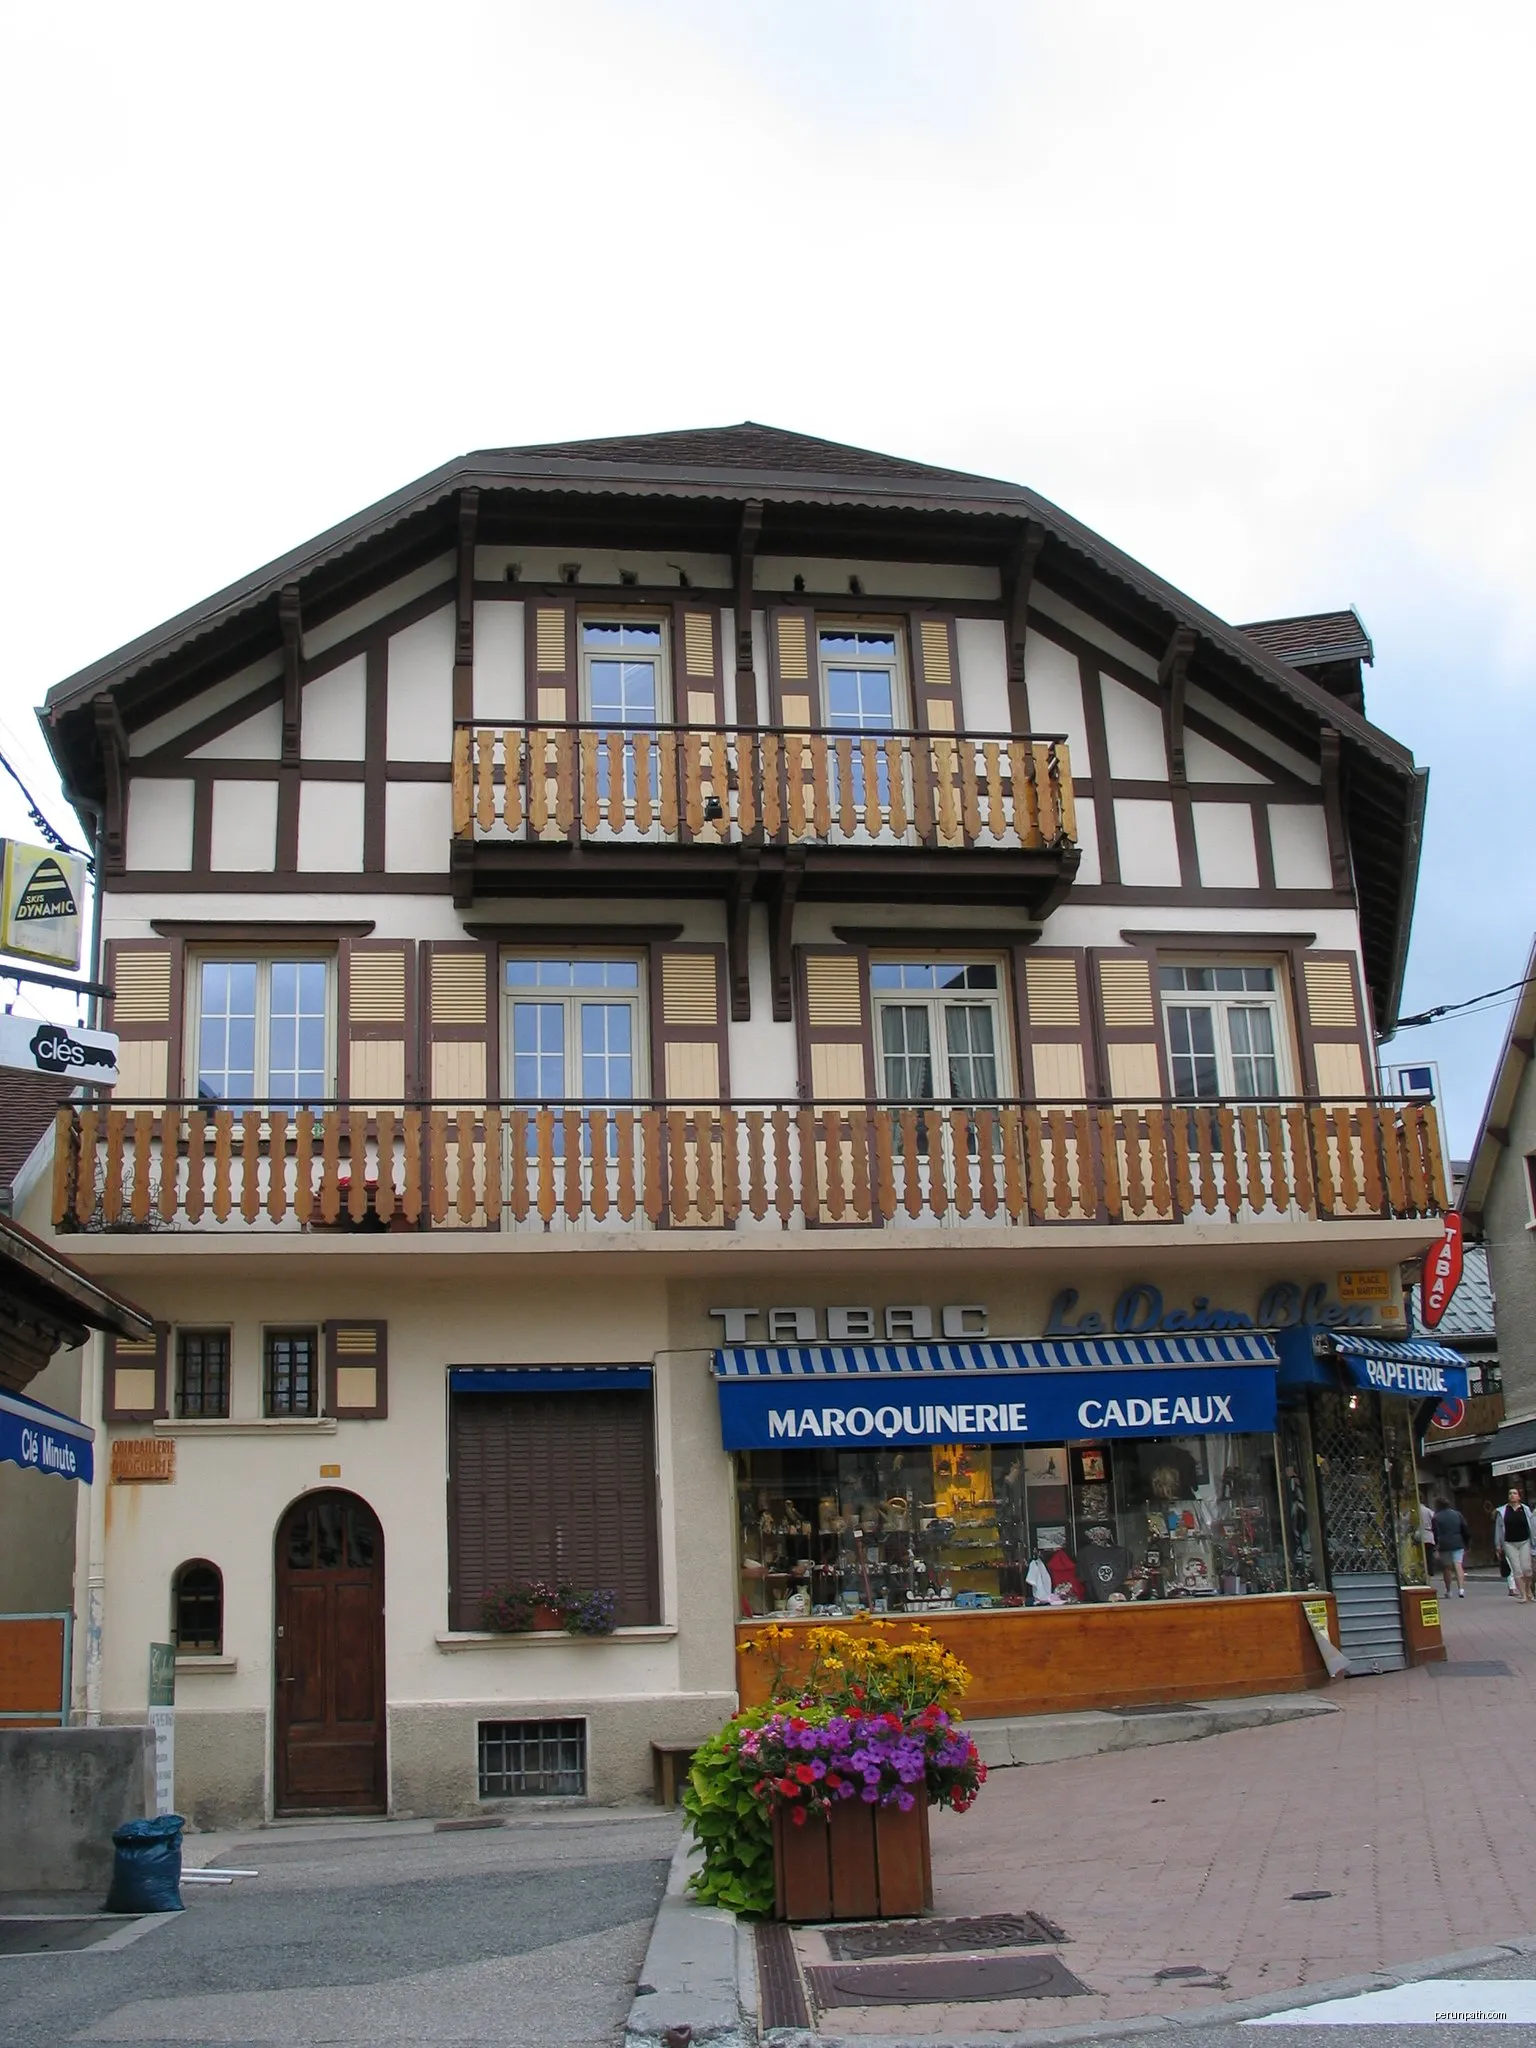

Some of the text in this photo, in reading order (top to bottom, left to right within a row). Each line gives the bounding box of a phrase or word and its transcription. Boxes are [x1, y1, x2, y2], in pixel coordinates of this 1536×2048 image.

[17, 900, 74, 918] DYNAMIC
[25, 894, 45, 904] SKIS
[38, 1037, 85, 1065] clés
[1429, 1227, 1457, 1310] TABAC
[709, 1305, 991, 1342] TABAC
[1044, 1287, 1107, 1337] Le
[1366, 1359, 1448, 1393] PAPETERIE
[768, 1395, 1235, 1439] MAROQUINERIE CADEAUX
[21, 1428, 77, 1473] Clé Minute
